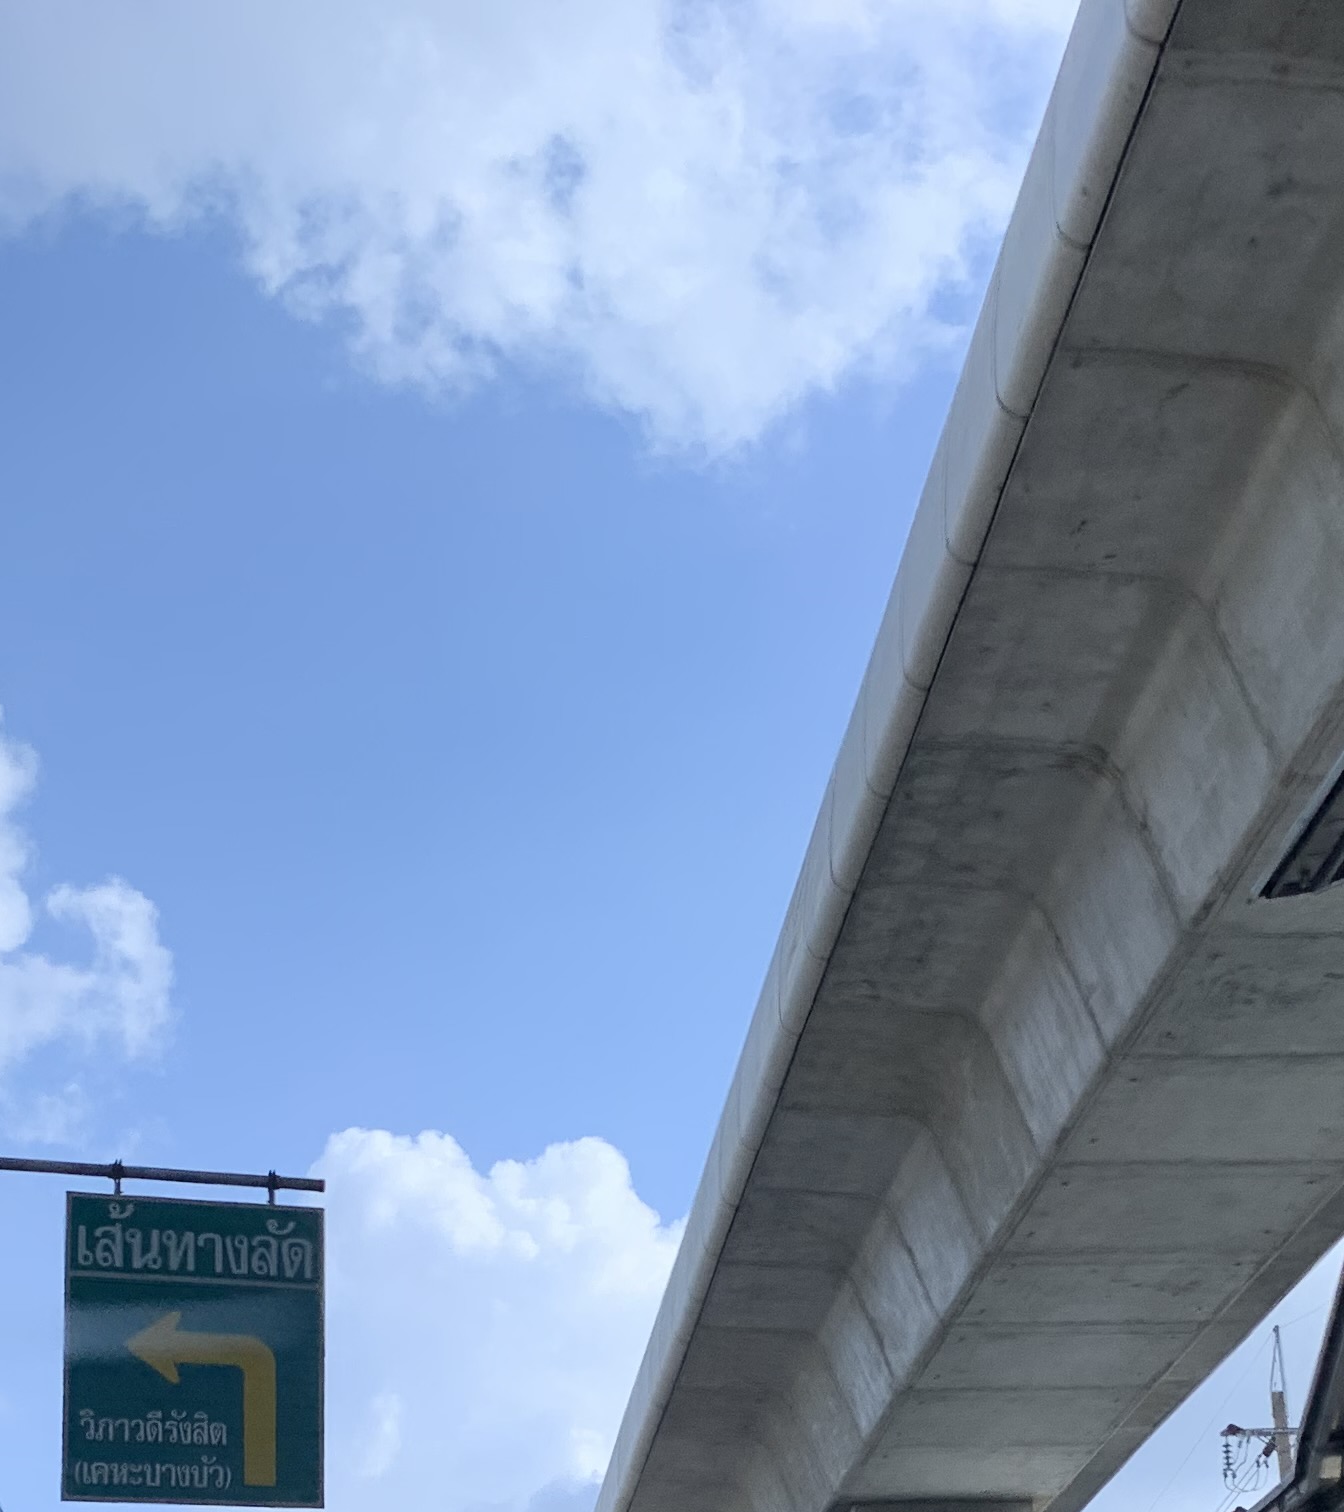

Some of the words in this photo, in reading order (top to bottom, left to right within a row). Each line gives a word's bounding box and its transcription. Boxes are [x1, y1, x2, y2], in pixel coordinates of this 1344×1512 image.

[77, 1202, 314, 1280] เส้นทางลัด
[79, 1408, 228, 1447] วิภาวดีรังสิต
[73, 1454, 233, 1491] (เคหะบางบัว)
